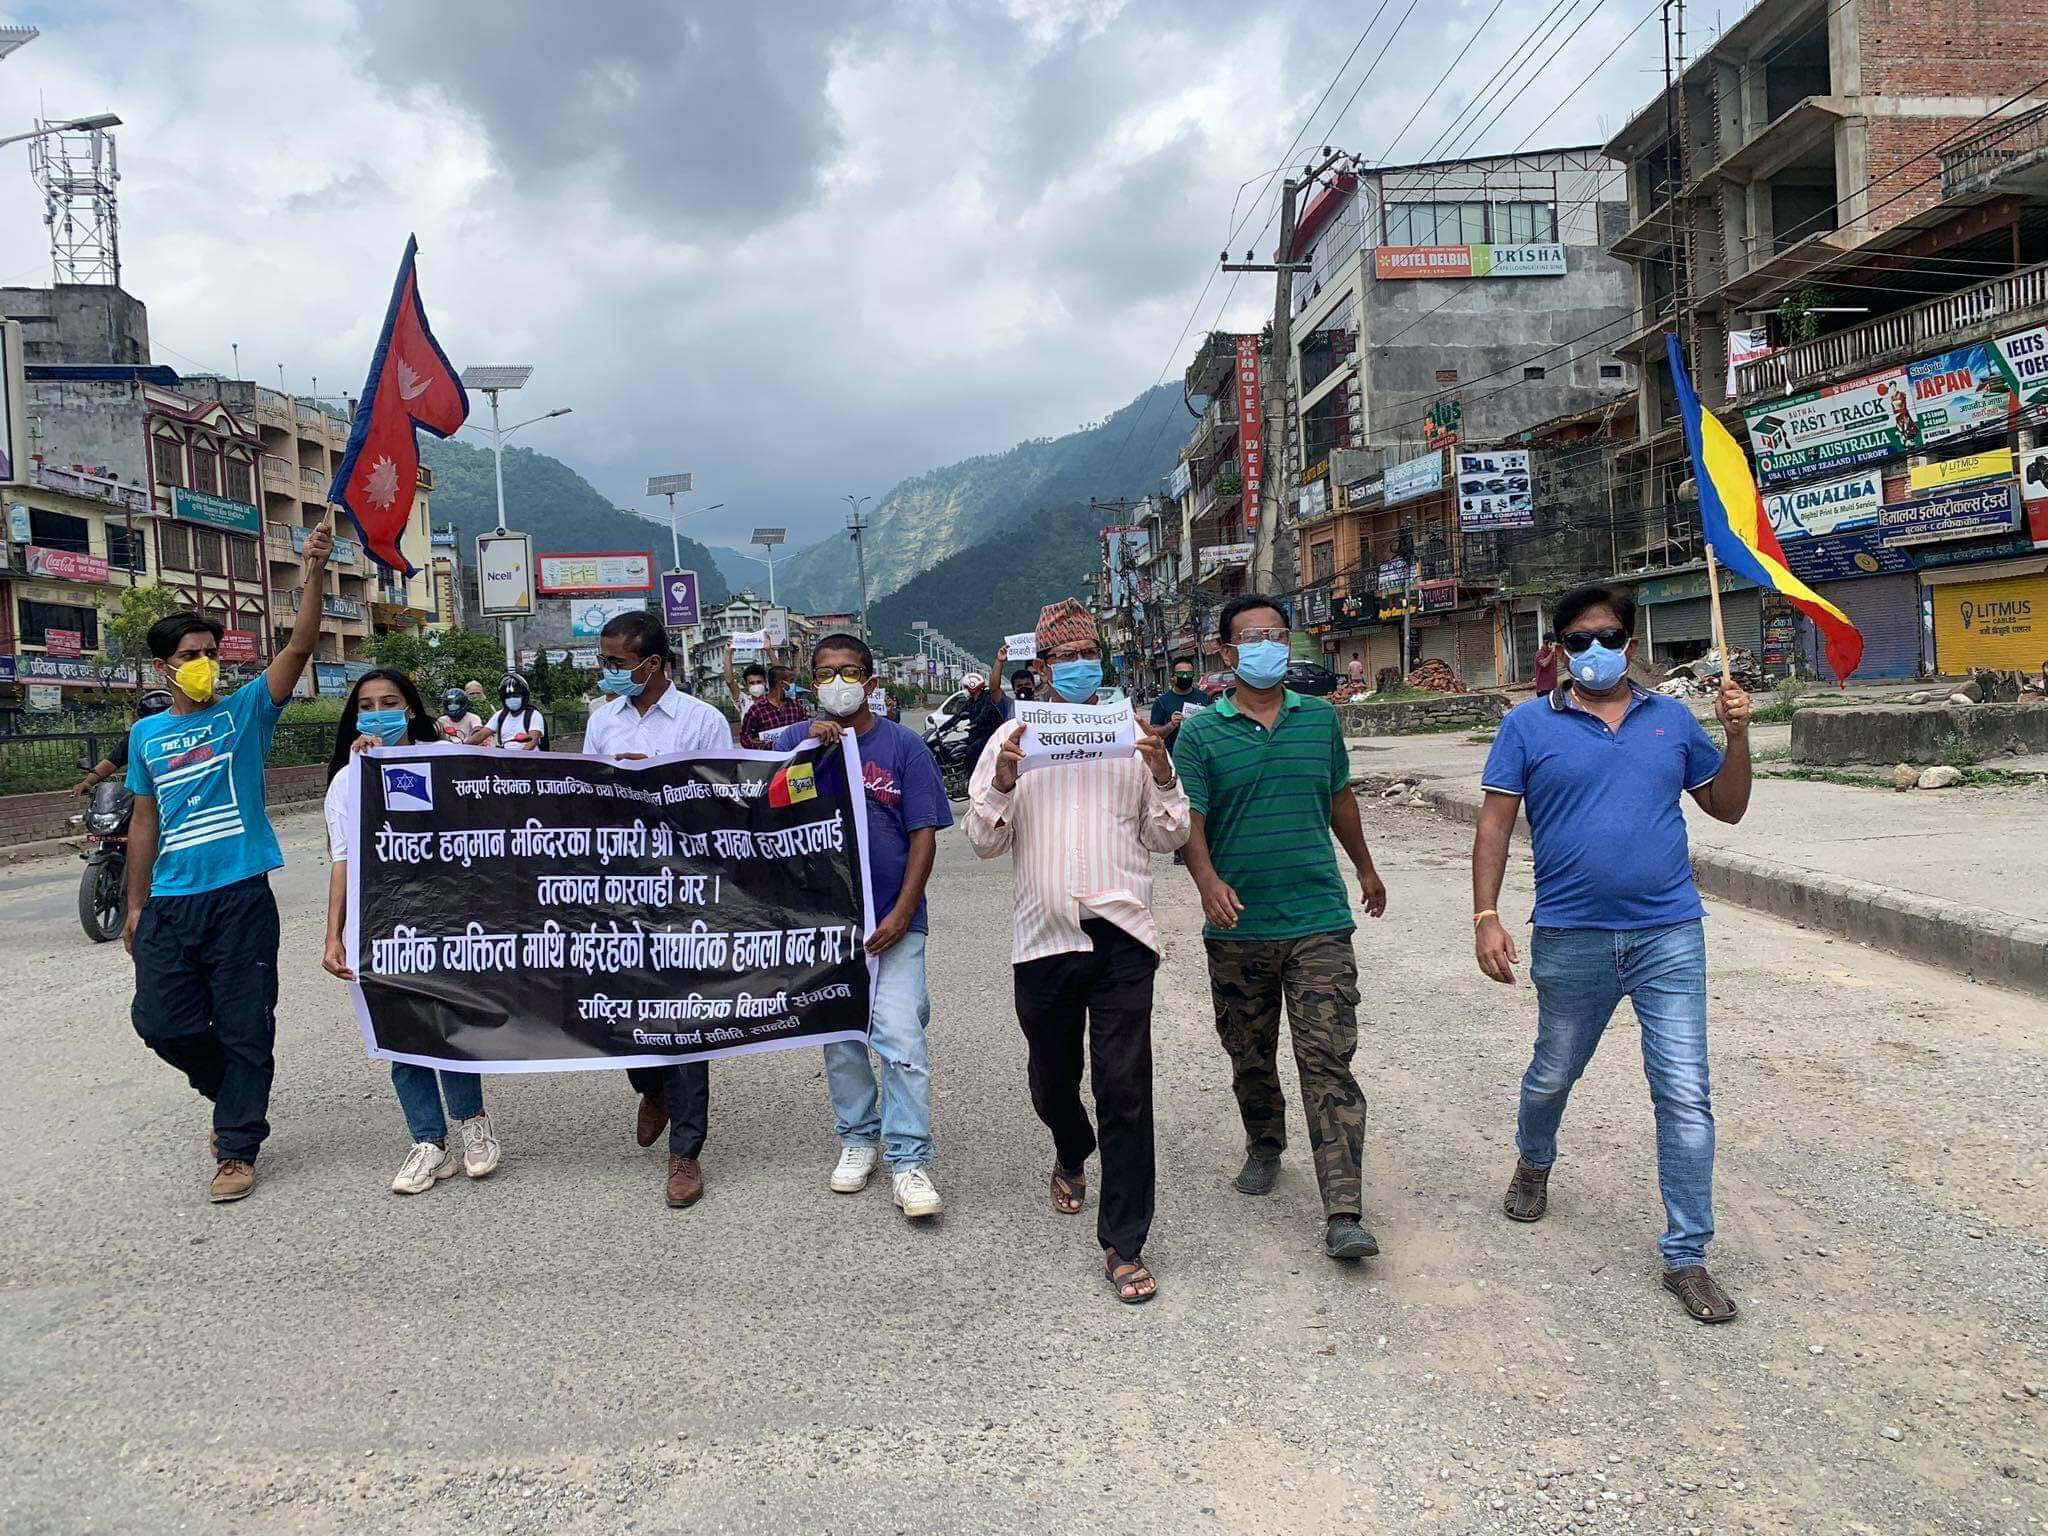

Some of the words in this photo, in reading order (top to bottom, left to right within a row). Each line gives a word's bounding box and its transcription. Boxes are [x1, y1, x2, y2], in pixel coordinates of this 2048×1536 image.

[1392, 253, 1427, 267] HOTEL
[1430, 252, 1469, 266] DELBIA
[1494, 250, 1561, 262] TRISHA
[2006, 334, 2045, 358] IELTS
[1910, 363, 1932, 376] Study
[1932, 361, 1943, 371] in
[1241, 358, 1256, 423] HOTEL
[1914, 368, 1973, 400] JAPAN
[1789, 406, 1817, 418] BUTWAL
[1791, 412, 1828, 435] FAST
[1830, 397, 1886, 424] TRACK
[1772, 450, 1806, 469] JAPAN
[1819, 431, 1891, 460] AUSTRALIA
[1802, 463, 1816, 473] NEW
[1818, 456, 1851, 470] ZEALAND
[1857, 448, 1889, 462] EUROPE
[1949, 457, 1979, 471] LITMUS
[1801, 509, 1818, 521] Digital
[1819, 508, 1832, 516] Print
[1855, 500, 1876, 510] Service
[1879, 508, 1917, 526] हिमालय
[487, 572, 512, 581] Ncell
[333, 600, 358, 614] ROYAL
[1977, 600, 2031, 618] LITMUS
[1021, 708, 1067, 725] धार्मिक
[1072, 710, 1129, 726] सम्प्रदाय
[161, 739, 181, 752] THE
[1038, 730, 1116, 746] खलबलाउन
[594, 783, 614, 798] तथा
[375, 820, 433, 864] रौतहट
[439, 829, 506, 867] हनुमान
[511, 818, 592, 860] मन्दिरका
[596, 819, 647, 866] पुजारी
[651, 822, 673, 858] श्री
[677, 831, 708, 858] राम
[755, 809, 843, 860] हत्यारालाई
[537, 875, 600, 906] तत्काल
[605, 866, 674, 907] कारवाही
[679, 875, 708, 906] गर
[372, 925, 438, 976] धार्मिक
[443, 922, 517, 973] व्यक्तित्व
[522, 920, 566, 969] माथि
[571, 920, 646, 975] भईरहेको
[650, 920, 729, 971] सांघातिक
[732, 930, 783, 972] हमला
[786, 928, 817, 968] बन्द
[820, 925, 845, 964] गर
[578, 993, 633, 1024] राष्ट्रिय
[638, 993, 733, 1021] प्रजातान्त्रिक
[735, 991, 789, 1020] विद्यार्थी
[791, 983, 852, 1009] संगठन
[633, 1029, 672, 1046] जिल्ला
[674, 1030, 702, 1046] कार्य
[750, 1015, 801, 1036] रुपन्देही
